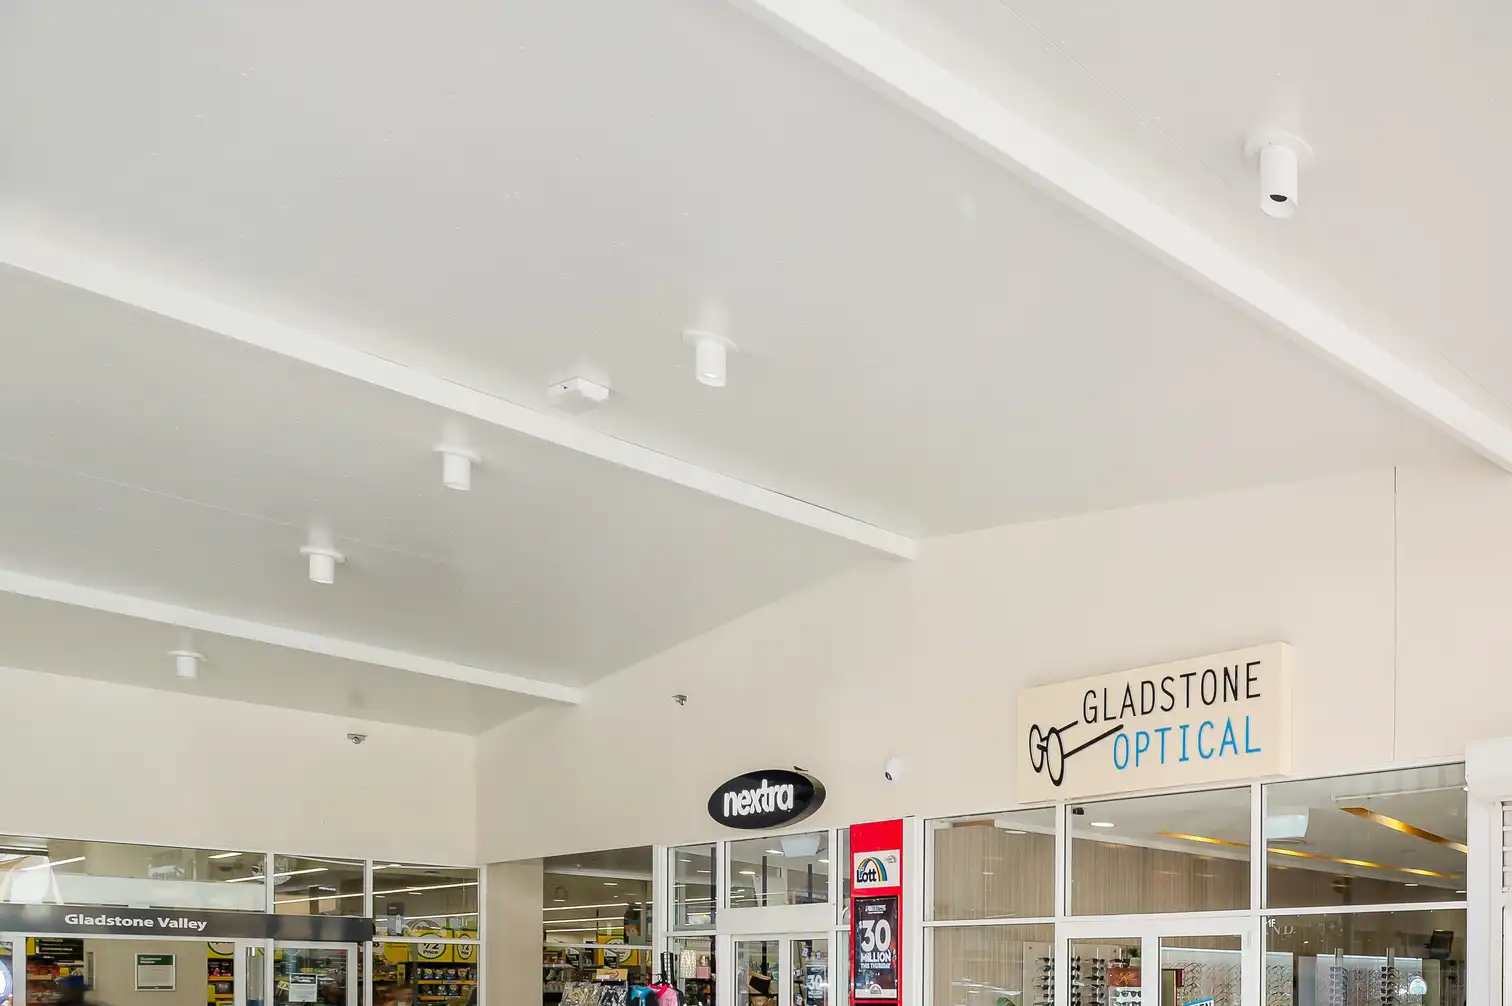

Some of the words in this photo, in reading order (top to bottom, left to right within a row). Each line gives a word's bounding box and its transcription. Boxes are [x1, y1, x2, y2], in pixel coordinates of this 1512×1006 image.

[1083, 660, 1261, 724] GLADSTONE
[1113, 715, 1261, 770] OPTICAL
[723, 778, 794, 817] nextra
[64, 913, 154, 929] Gladstone
[157, 917, 208, 932] Valley
[858, 918, 892, 952] $30
[860, 949, 892, 963] MILLION
